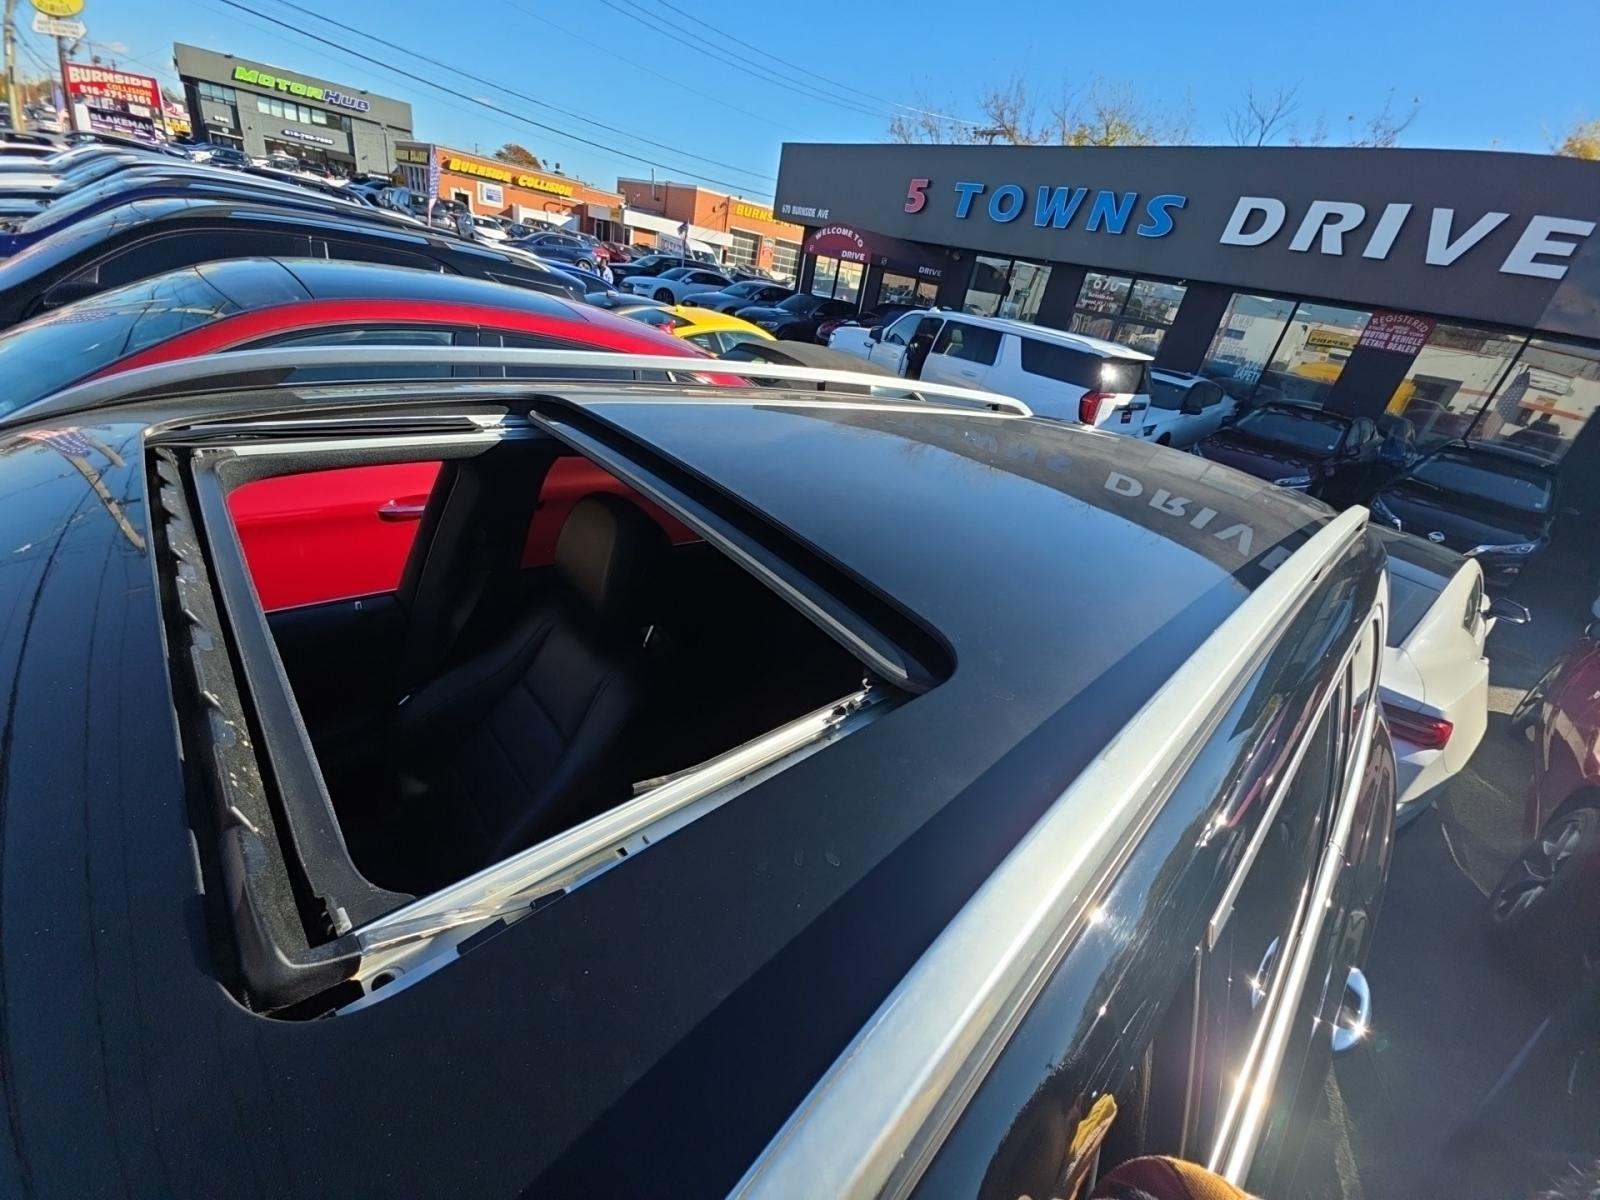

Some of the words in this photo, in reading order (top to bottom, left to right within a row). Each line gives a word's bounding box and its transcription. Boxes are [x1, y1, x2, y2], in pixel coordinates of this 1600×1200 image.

[69, 66, 154, 89] BURNSIDE
[106, 82, 154, 98] COLLISION
[450, 157, 511, 182] BURNSIDE
[518, 174, 573, 198] COLLISION
[791, 206, 816, 218] BURNSIDE
[816, 209, 830, 220] AVE
[815, 226, 854, 241] WELCOME
[853, 233, 864, 248] TO
[904, 178, 929, 214] 5
[954, 181, 1187, 237] TOWNS
[1219, 195, 1598, 281] DRIVE
[841, 250, 866, 261] DRIVE
[918, 265, 943, 278] DRIVE
[1371, 314, 1430, 333] REGISTERED
[1364, 329, 1391, 341] MOTOR
[1391, 334, 1425, 346] VEHICLE
[1386, 342, 1418, 354] DEALER
